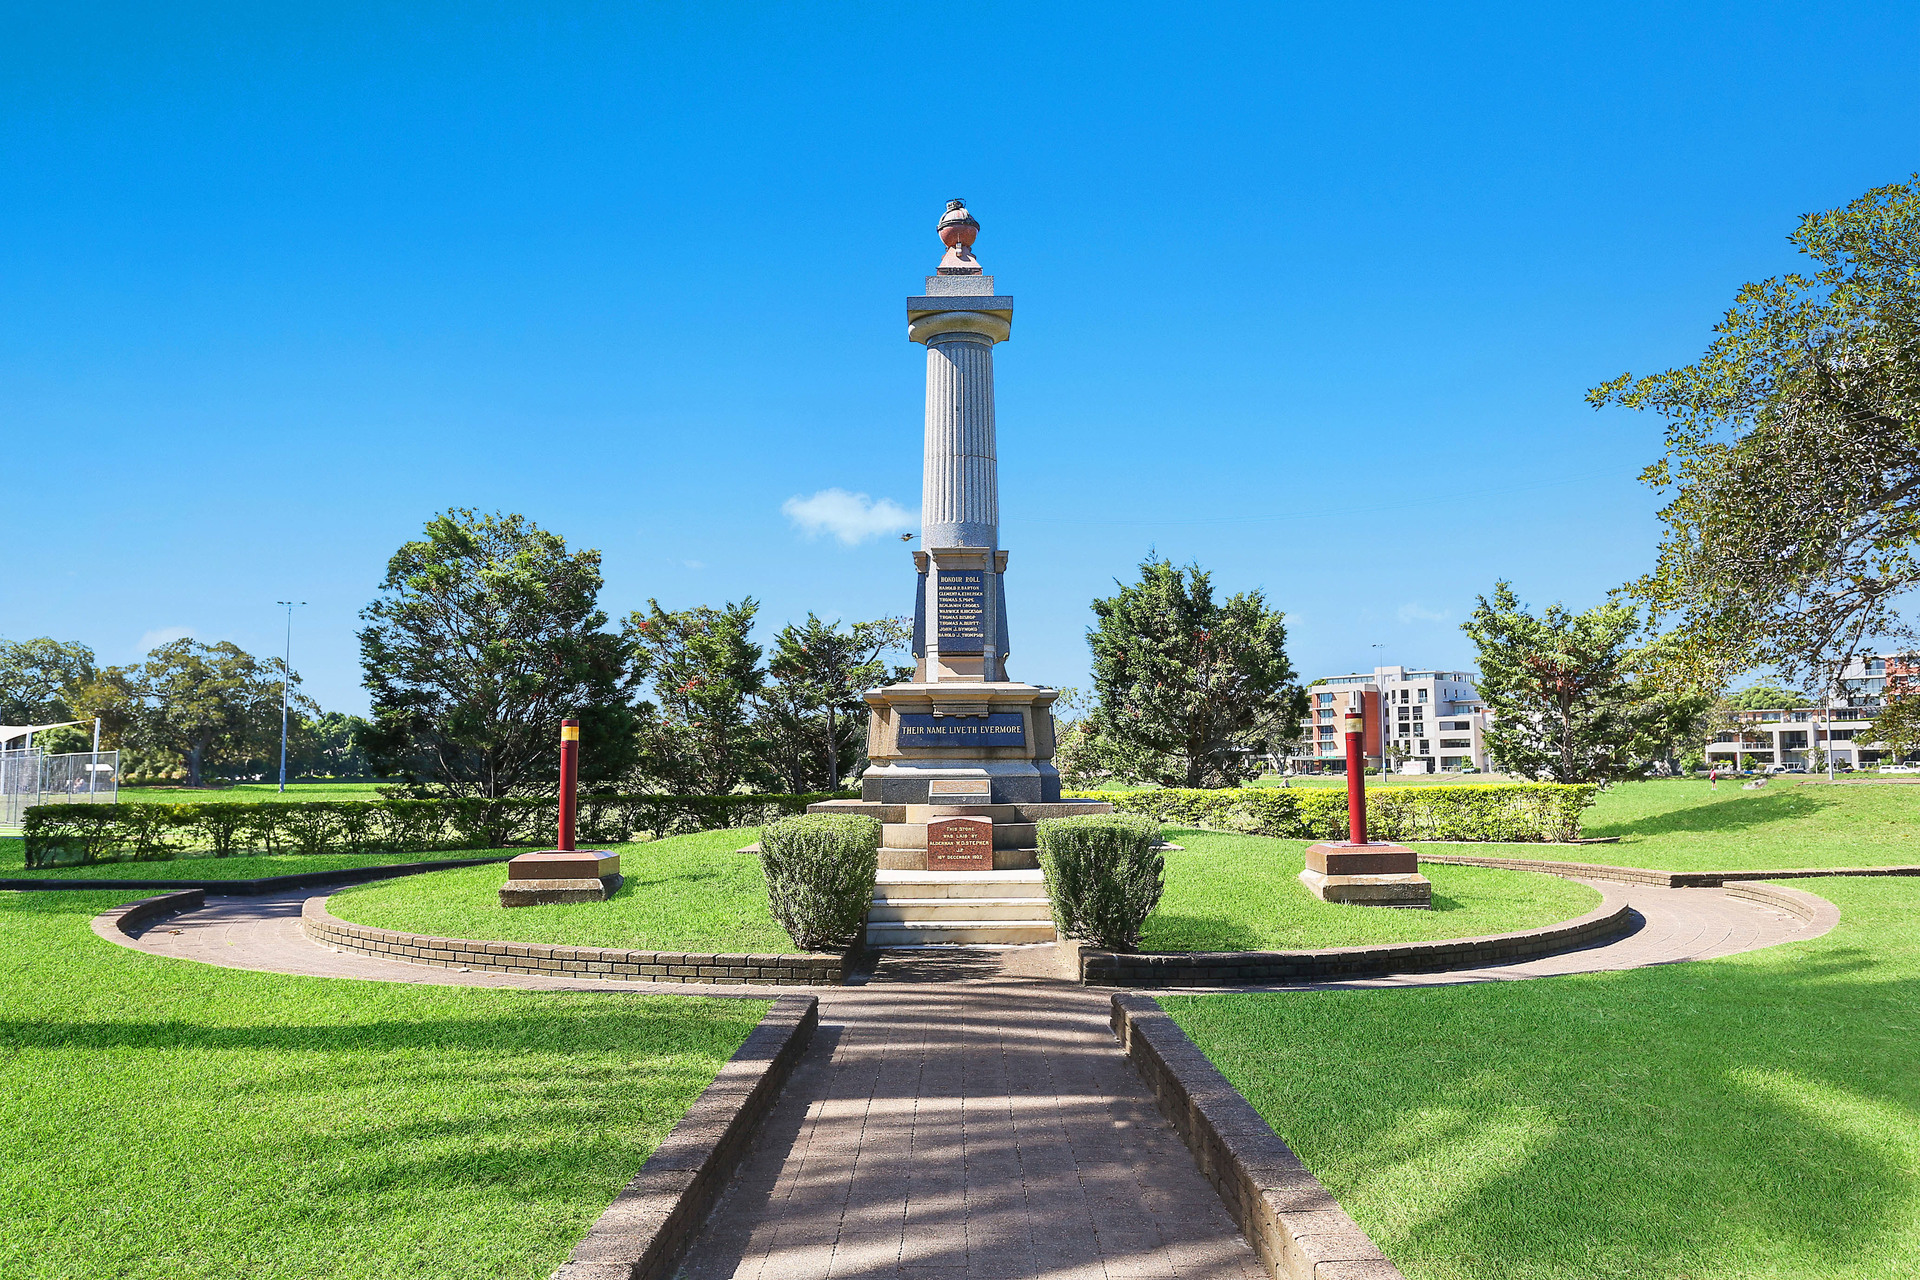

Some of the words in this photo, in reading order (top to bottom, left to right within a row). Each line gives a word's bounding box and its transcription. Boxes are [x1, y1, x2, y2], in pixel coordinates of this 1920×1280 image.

[902, 726, 925, 735] THEIR
[926, 726, 947, 734] NAME
[949, 726, 977, 734] LIVETH
[980, 725, 1022, 734] EVERMORE
